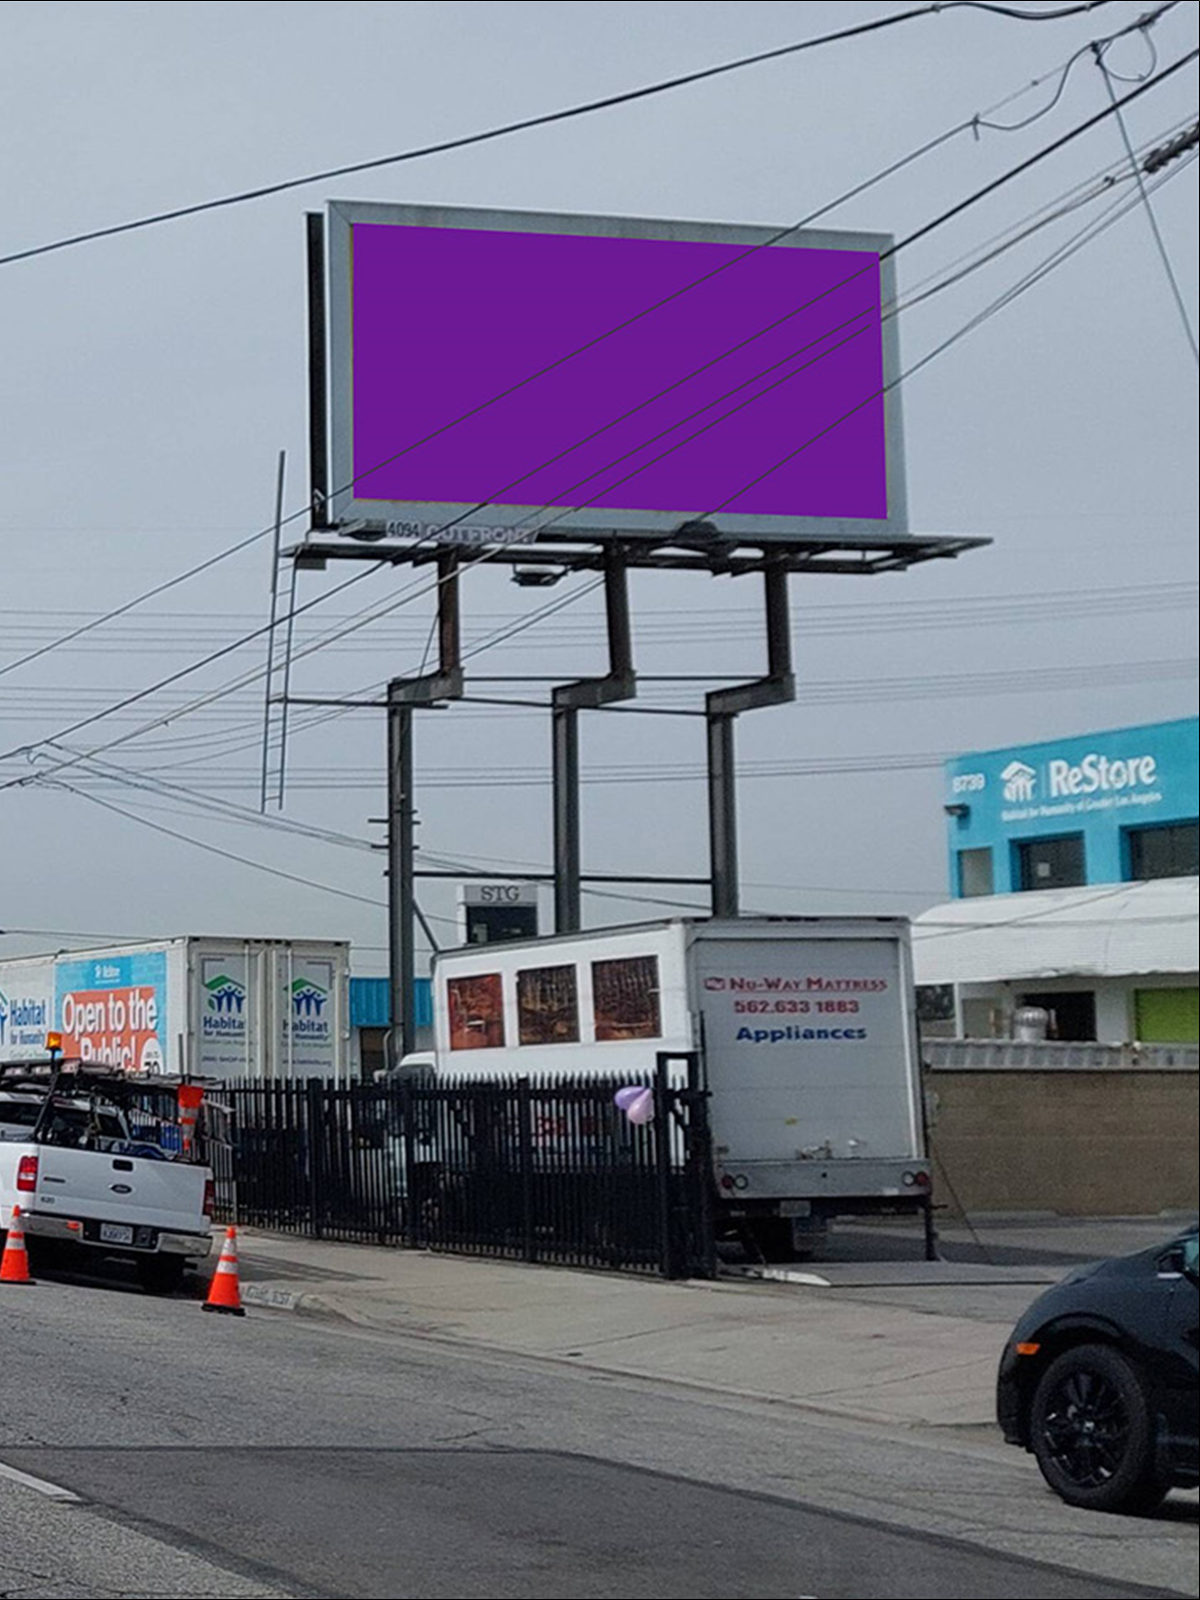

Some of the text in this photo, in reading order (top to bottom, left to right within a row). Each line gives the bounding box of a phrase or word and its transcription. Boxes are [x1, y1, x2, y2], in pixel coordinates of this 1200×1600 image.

[952, 773, 986, 793] 8739
[1050, 754, 1158, 797] ReStore
[481, 885, 519, 901] STG
[10, 999, 46, 1027] Habitat
[62, 988, 158, 1042] Open to the
[203, 1016, 247, 1030] Habita
[736, 1025, 868, 1043] Appliances
[80, 1036, 136, 1070] Public!
